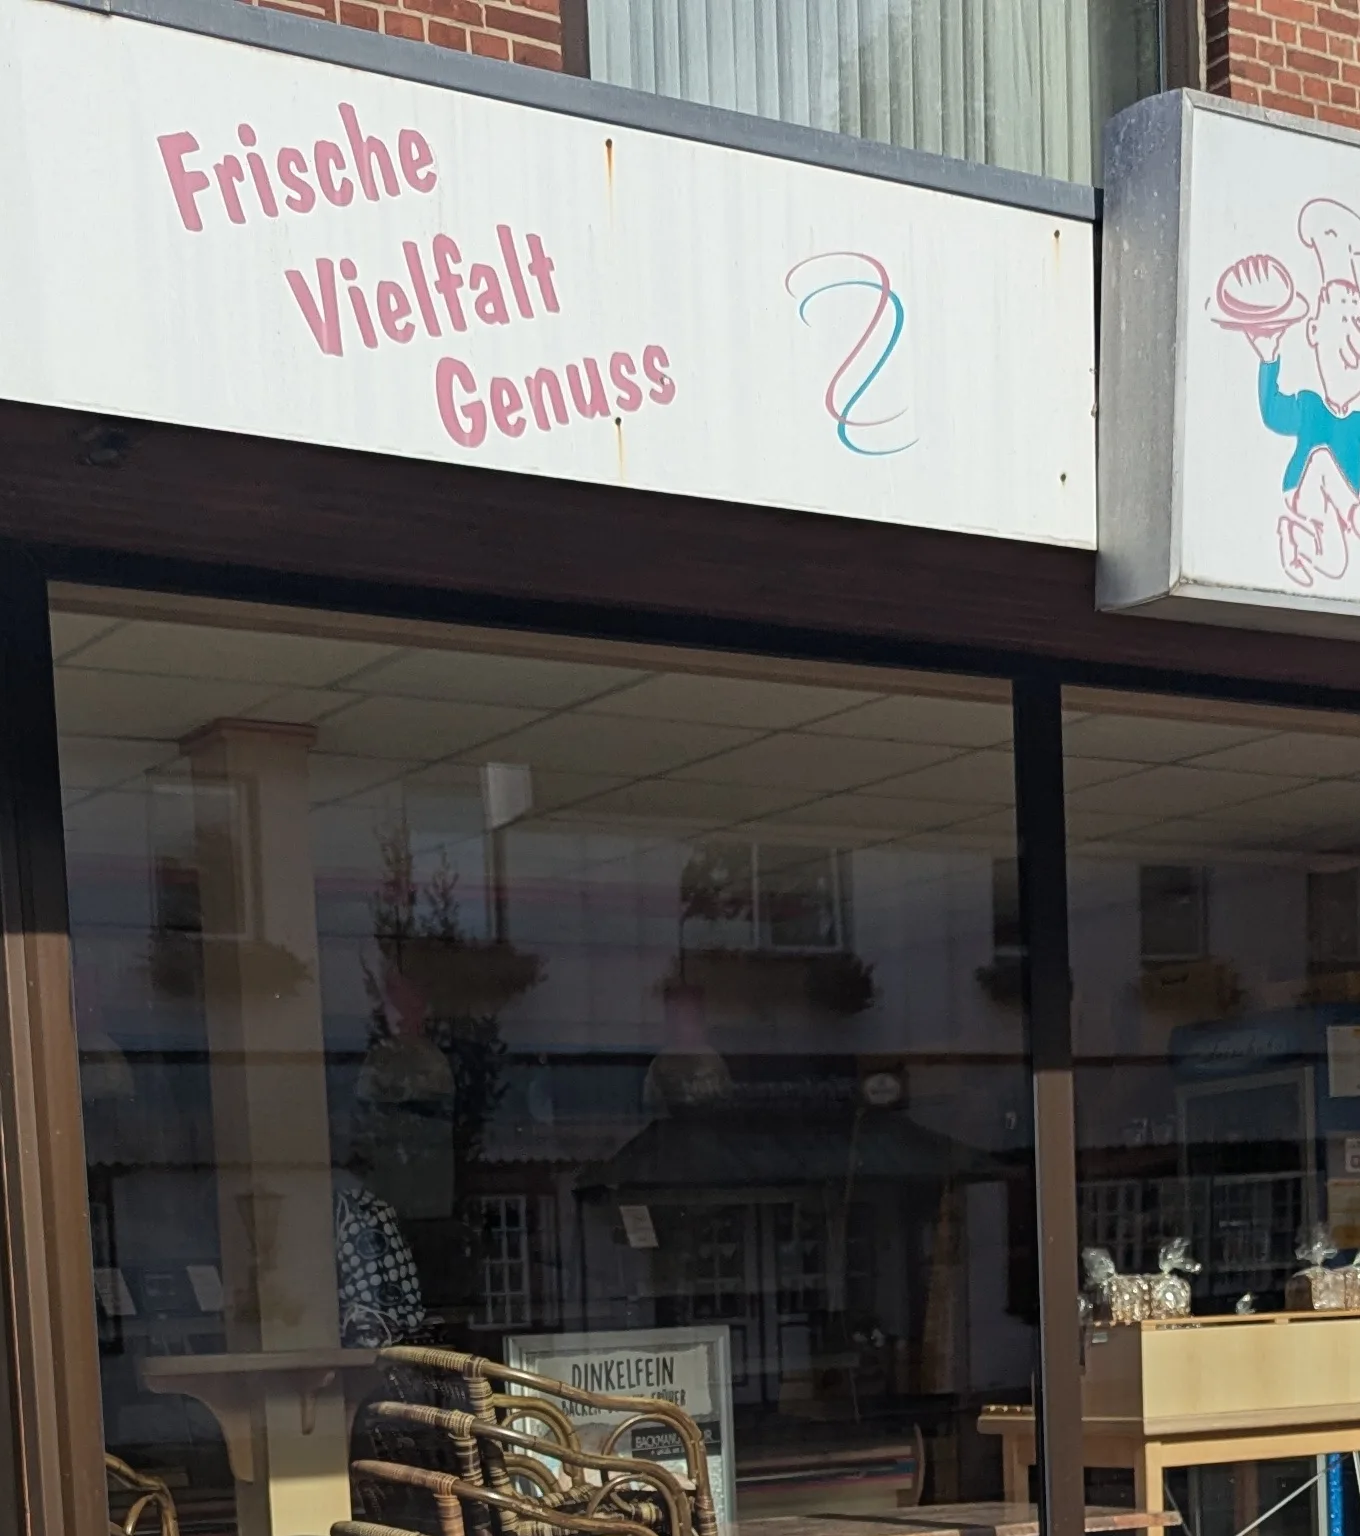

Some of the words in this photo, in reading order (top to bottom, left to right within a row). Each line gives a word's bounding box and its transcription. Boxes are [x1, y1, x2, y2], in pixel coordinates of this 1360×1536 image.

[157, 102, 438, 233] Frische
[285, 225, 560, 357] Vielfalt
[437, 345, 676, 449] Genuss
[572, 1357, 674, 1392] DINKELFEIN
